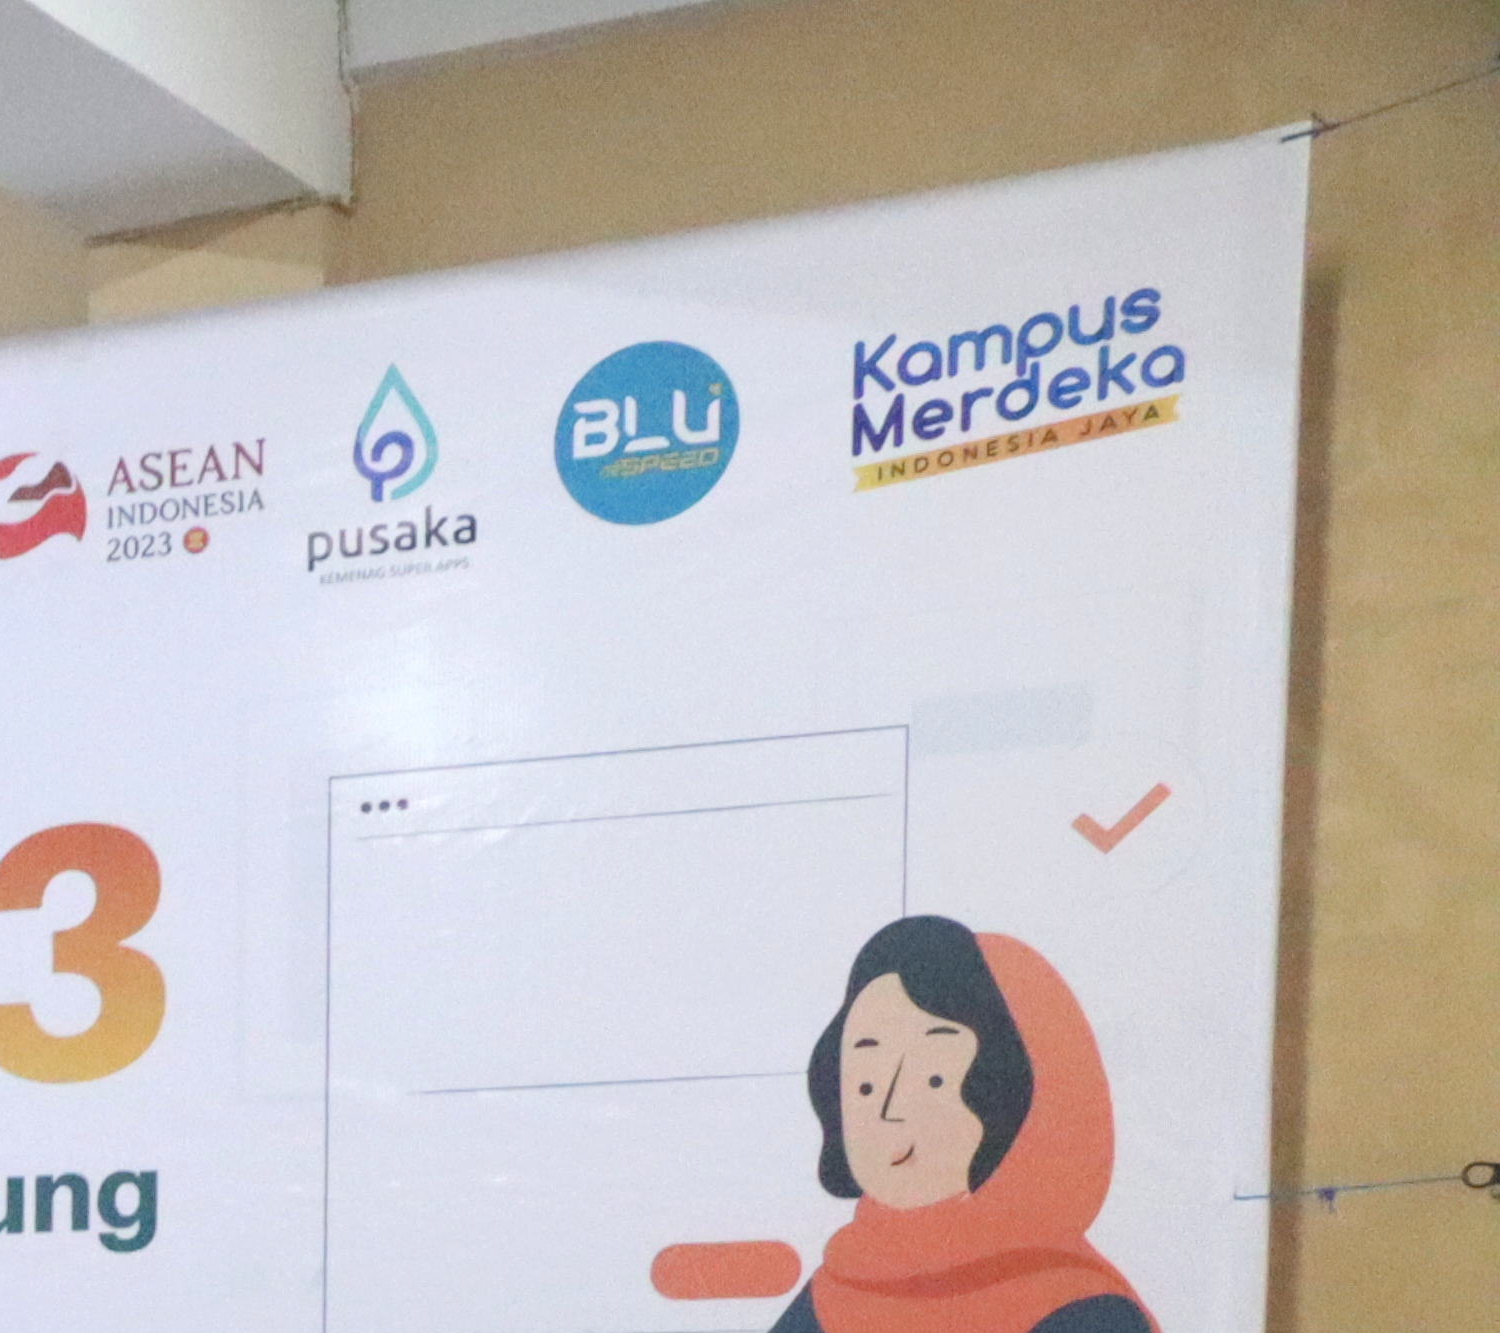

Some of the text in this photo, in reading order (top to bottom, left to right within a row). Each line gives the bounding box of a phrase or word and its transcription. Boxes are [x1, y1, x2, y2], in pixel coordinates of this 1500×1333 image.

[853, 287, 1161, 400] Kampus
[573, 389, 721, 460] BLU
[852, 345, 1185, 456] Merdeka
[107, 439, 266, 495] ASEAN
[877, 404, 1161, 481] INDONESIA JAYA
[107, 489, 265, 530] INDONESIA
[307, 505, 477, 572] pusaka
[106, 532, 173, 563] 2023
